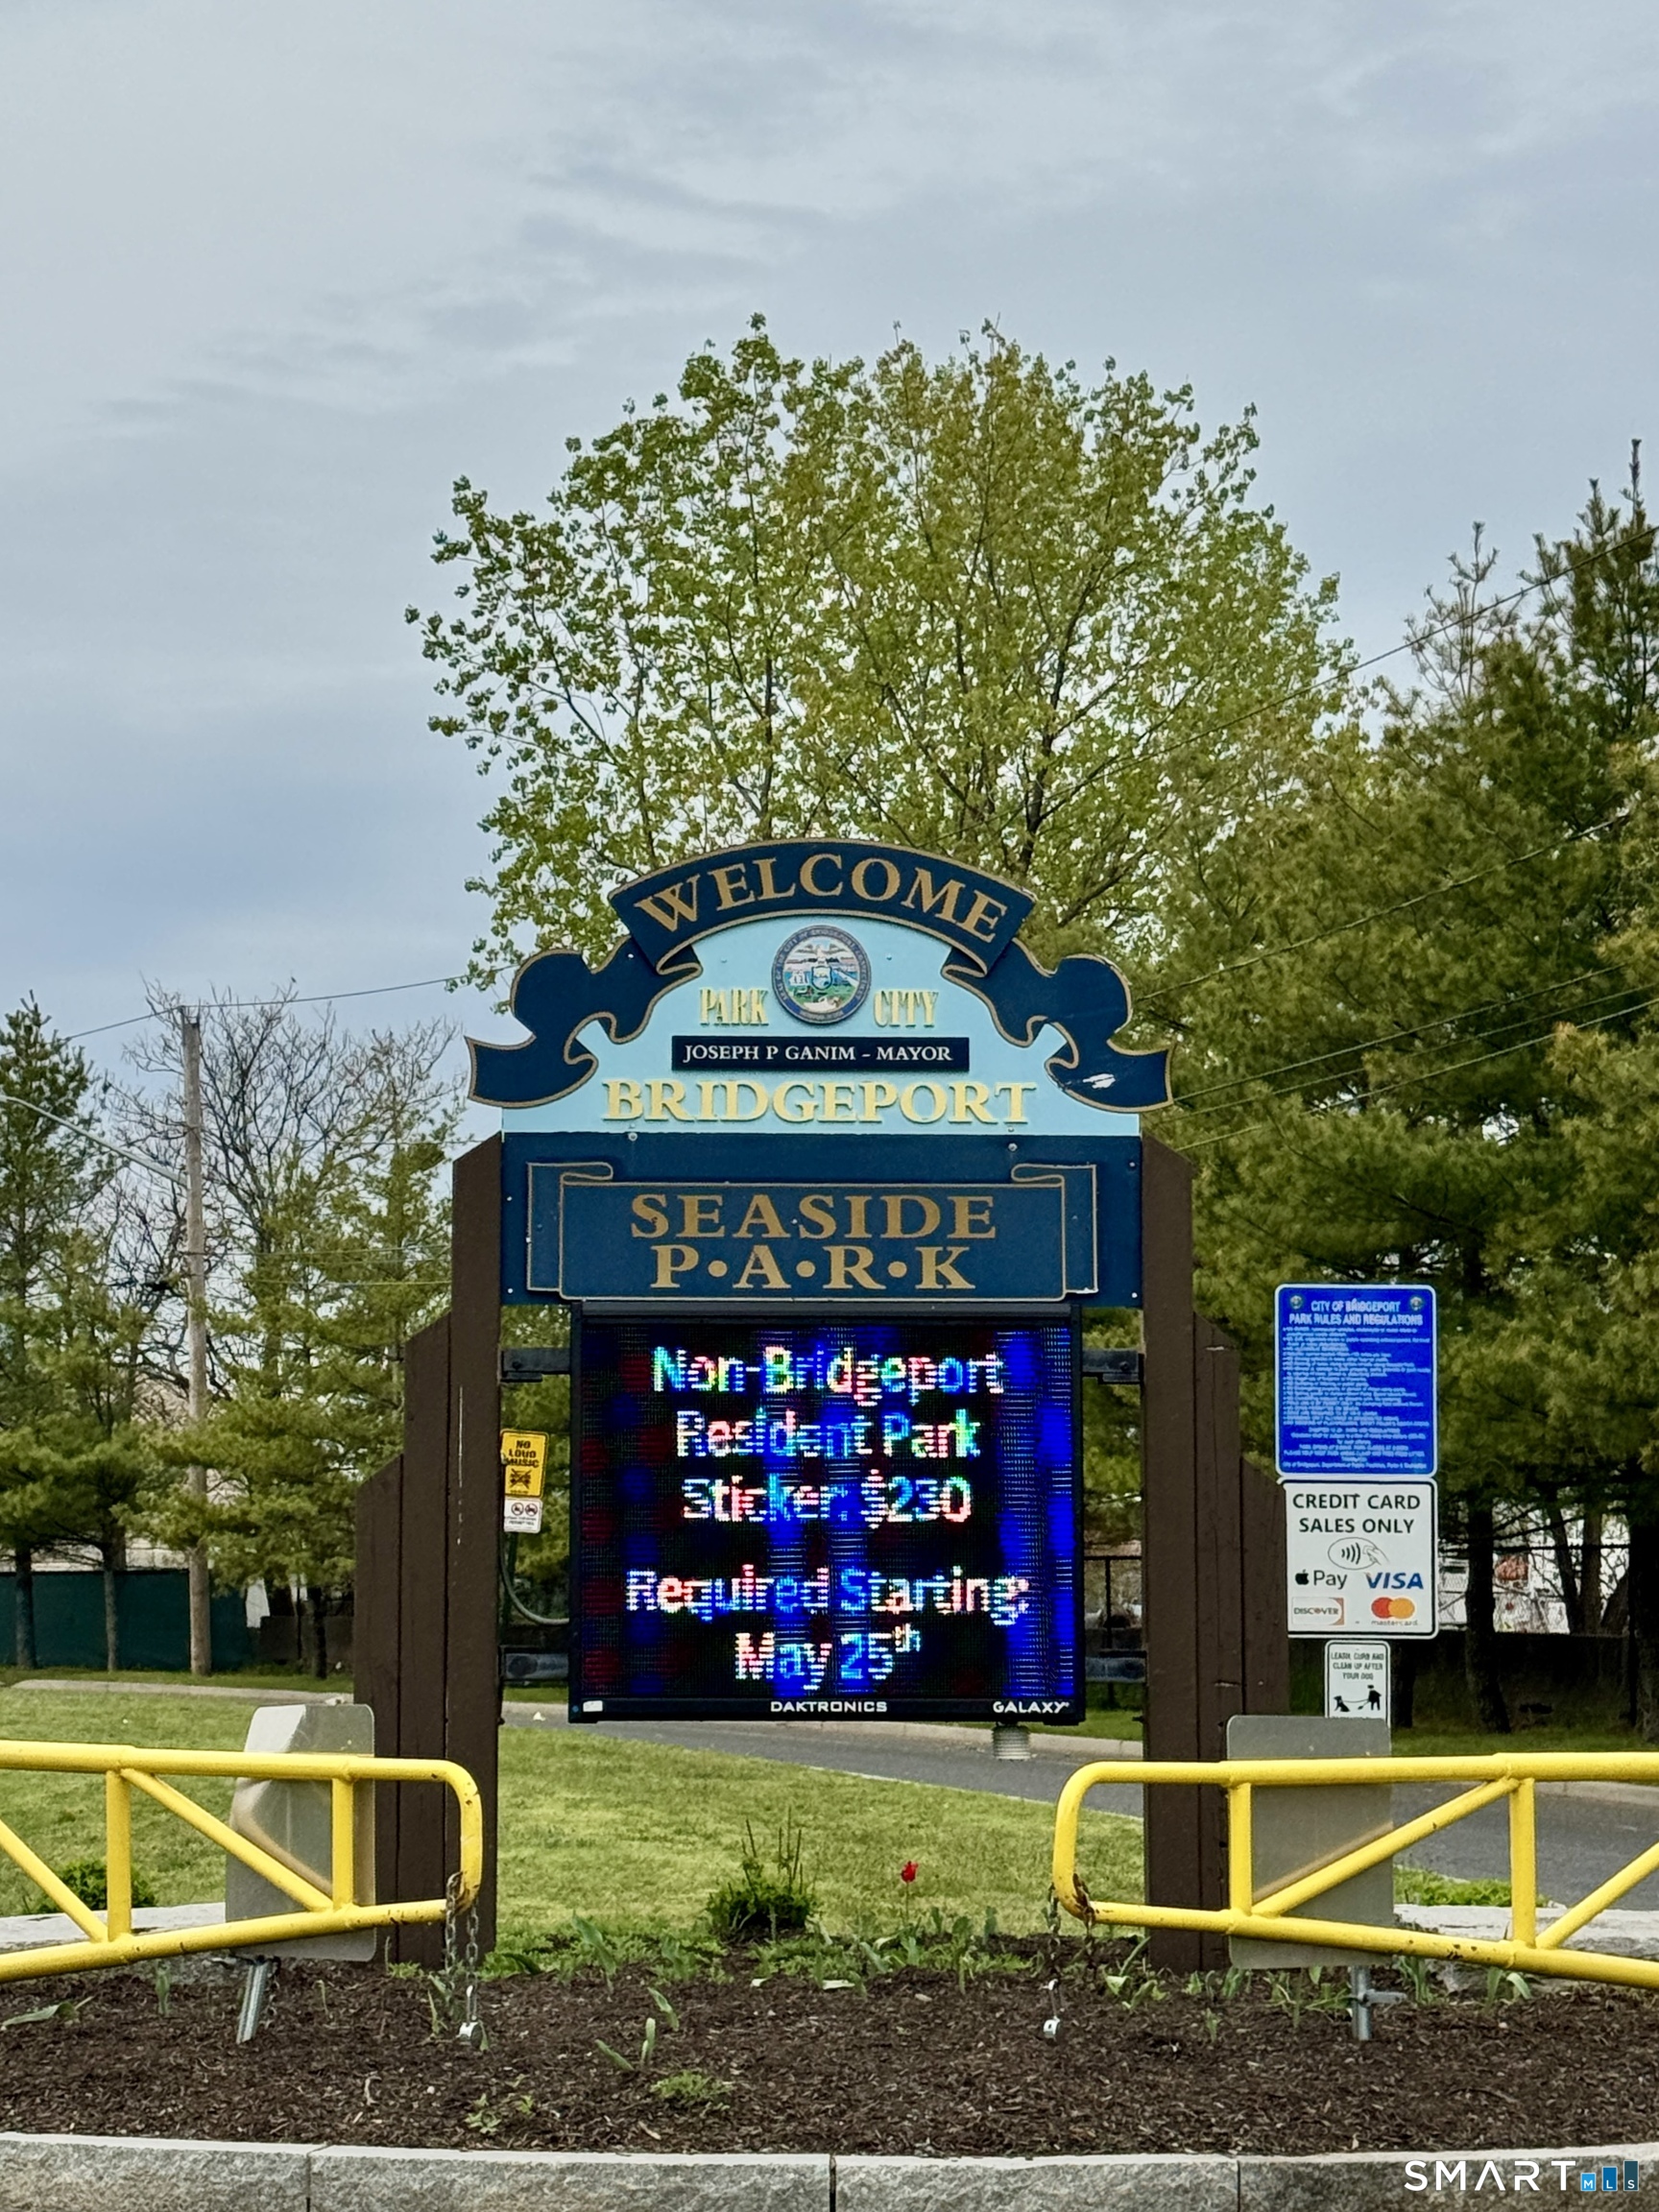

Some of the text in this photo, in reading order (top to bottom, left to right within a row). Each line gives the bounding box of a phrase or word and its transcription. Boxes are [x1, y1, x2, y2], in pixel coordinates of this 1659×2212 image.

[634, 853, 1008, 943] WELCOME
[699, 989, 769, 1025] PARK
[873, 990, 939, 1027] CITY
[683, 1044, 758, 1062] JOSEPH
[765, 1046, 779, 1060] P
[785, 1046, 854, 1061] GANIM
[876, 1046, 953, 1062] MAYOR
[602, 1078, 1038, 1124] BRIDGEPORT
[631, 1193, 997, 1239] SEASIDE
[1311, 1301, 1401, 1312] CITY OF BRIDGEPORT
[1289, 1313, 1423, 1326] PARK RULES AND REGULATIONS
[651, 1345, 1003, 1407] Non-Bridgeport
[676, 1408, 981, 1458] Resident Park
[516, 1440, 531, 1449] NO
[509, 1449, 536, 1458] LOUD
[506, 1457, 540, 1468] MUSIC
[1292, 1493, 1421, 1509] CREDIT CARD
[1299, 1517, 1414, 1533] SALES ONLY
[1313, 1570, 1347, 1590] Pay
[1365, 1572, 1424, 1589] VISA
[626, 1564, 830, 1623] Required
[1293, 1606, 1339, 1615] DISCOVER
[735, 1623, 922, 1690] May 25th
[1372, 1652, 1384, 1661] AND
[770, 1701, 887, 1713] DAKTRONICS
[993, 1701, 1064, 1714] GALAXY
